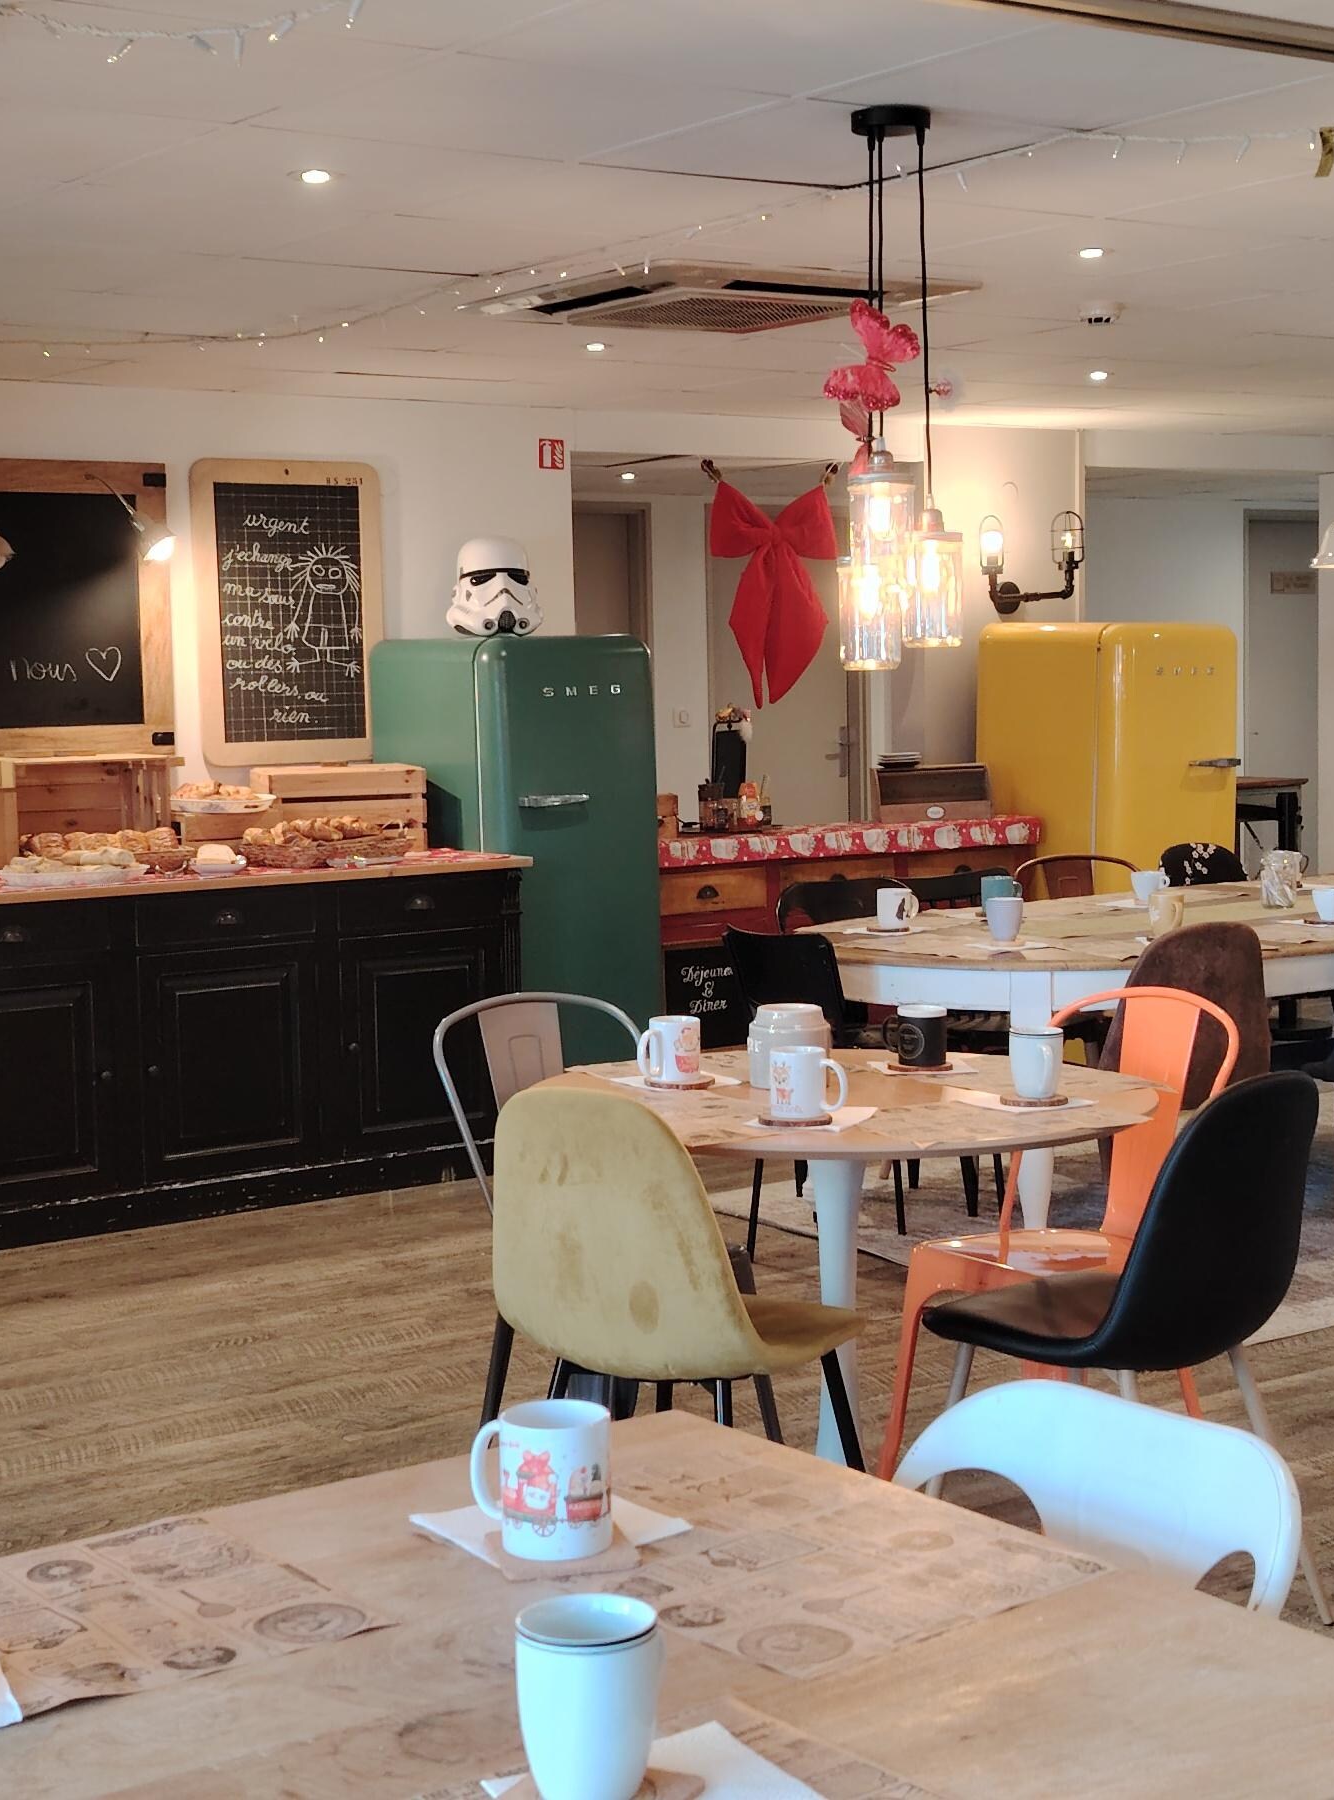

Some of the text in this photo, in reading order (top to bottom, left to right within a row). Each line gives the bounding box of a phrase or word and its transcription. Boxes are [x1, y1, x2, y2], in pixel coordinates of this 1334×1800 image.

[243, 513, 309, 537] urgent
[221, 609, 275, 630] contre
[542, 684, 622, 697] SMEG
